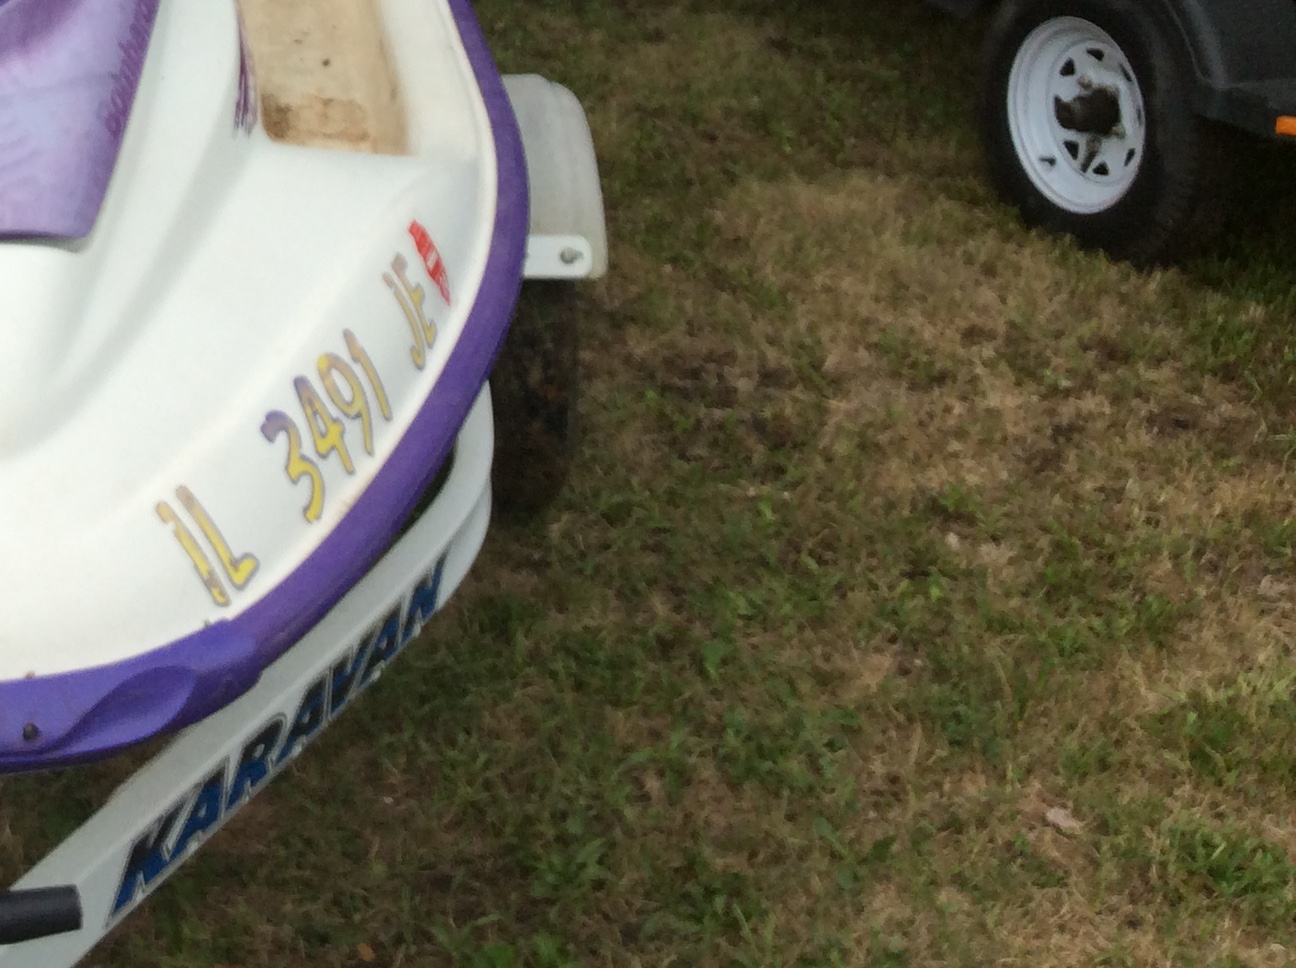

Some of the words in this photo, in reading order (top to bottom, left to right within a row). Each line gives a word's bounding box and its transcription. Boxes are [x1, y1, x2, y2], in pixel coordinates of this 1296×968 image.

[155, 485, 260, 607] IL
[260, 328, 393, 524] 3491
[107, 544, 452, 929] KARAVAN
